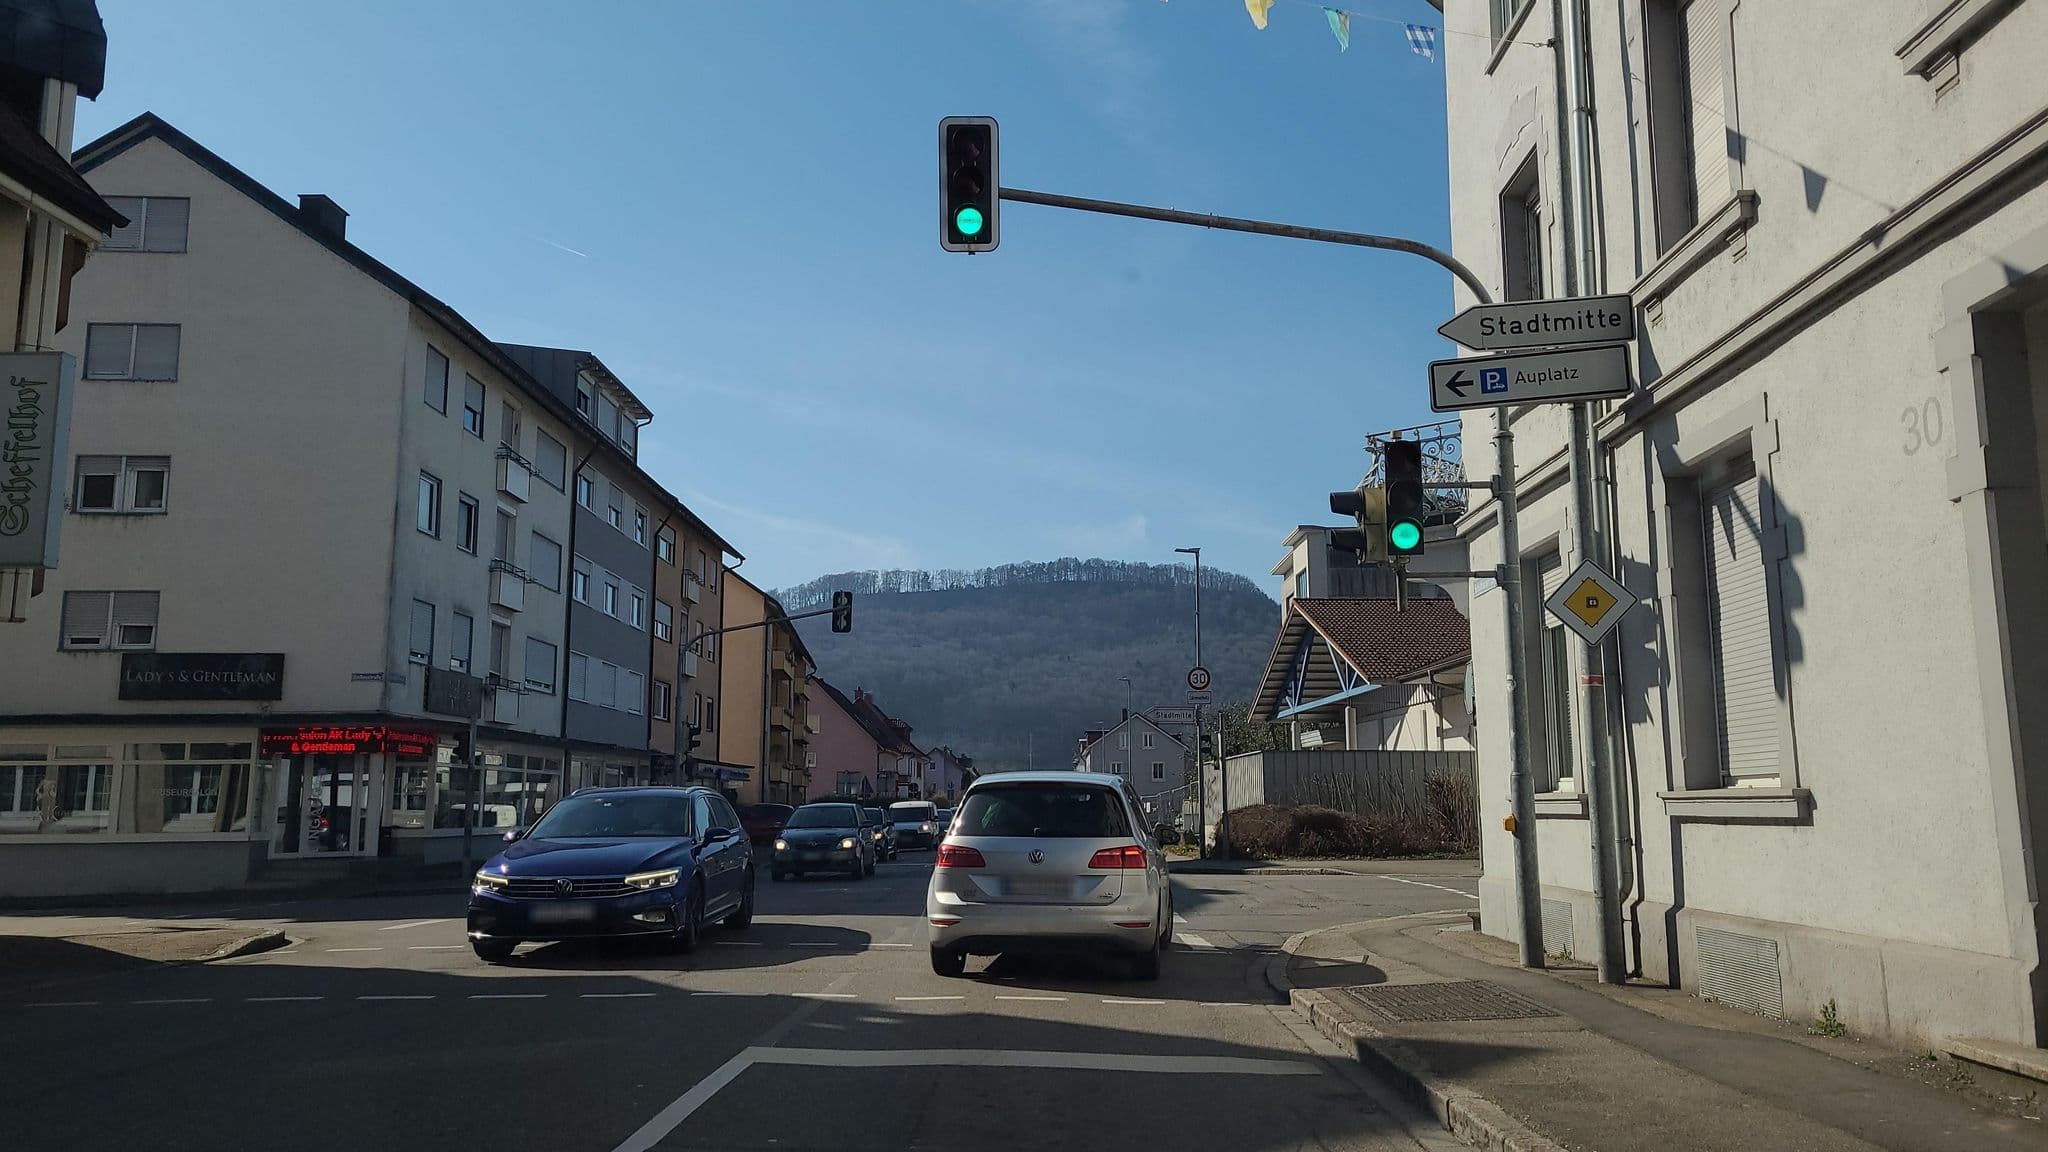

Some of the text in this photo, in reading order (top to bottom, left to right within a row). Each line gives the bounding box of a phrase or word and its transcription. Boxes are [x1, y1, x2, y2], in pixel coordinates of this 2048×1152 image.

[1480, 308, 1622, 337] Stadtmitte
[1514, 367, 1580, 386] Auplatz
[1901, 396, 1943, 457] 30
[1192, 673, 1206, 684] 30
[1156, 711, 1192, 719] Stadtmitte
